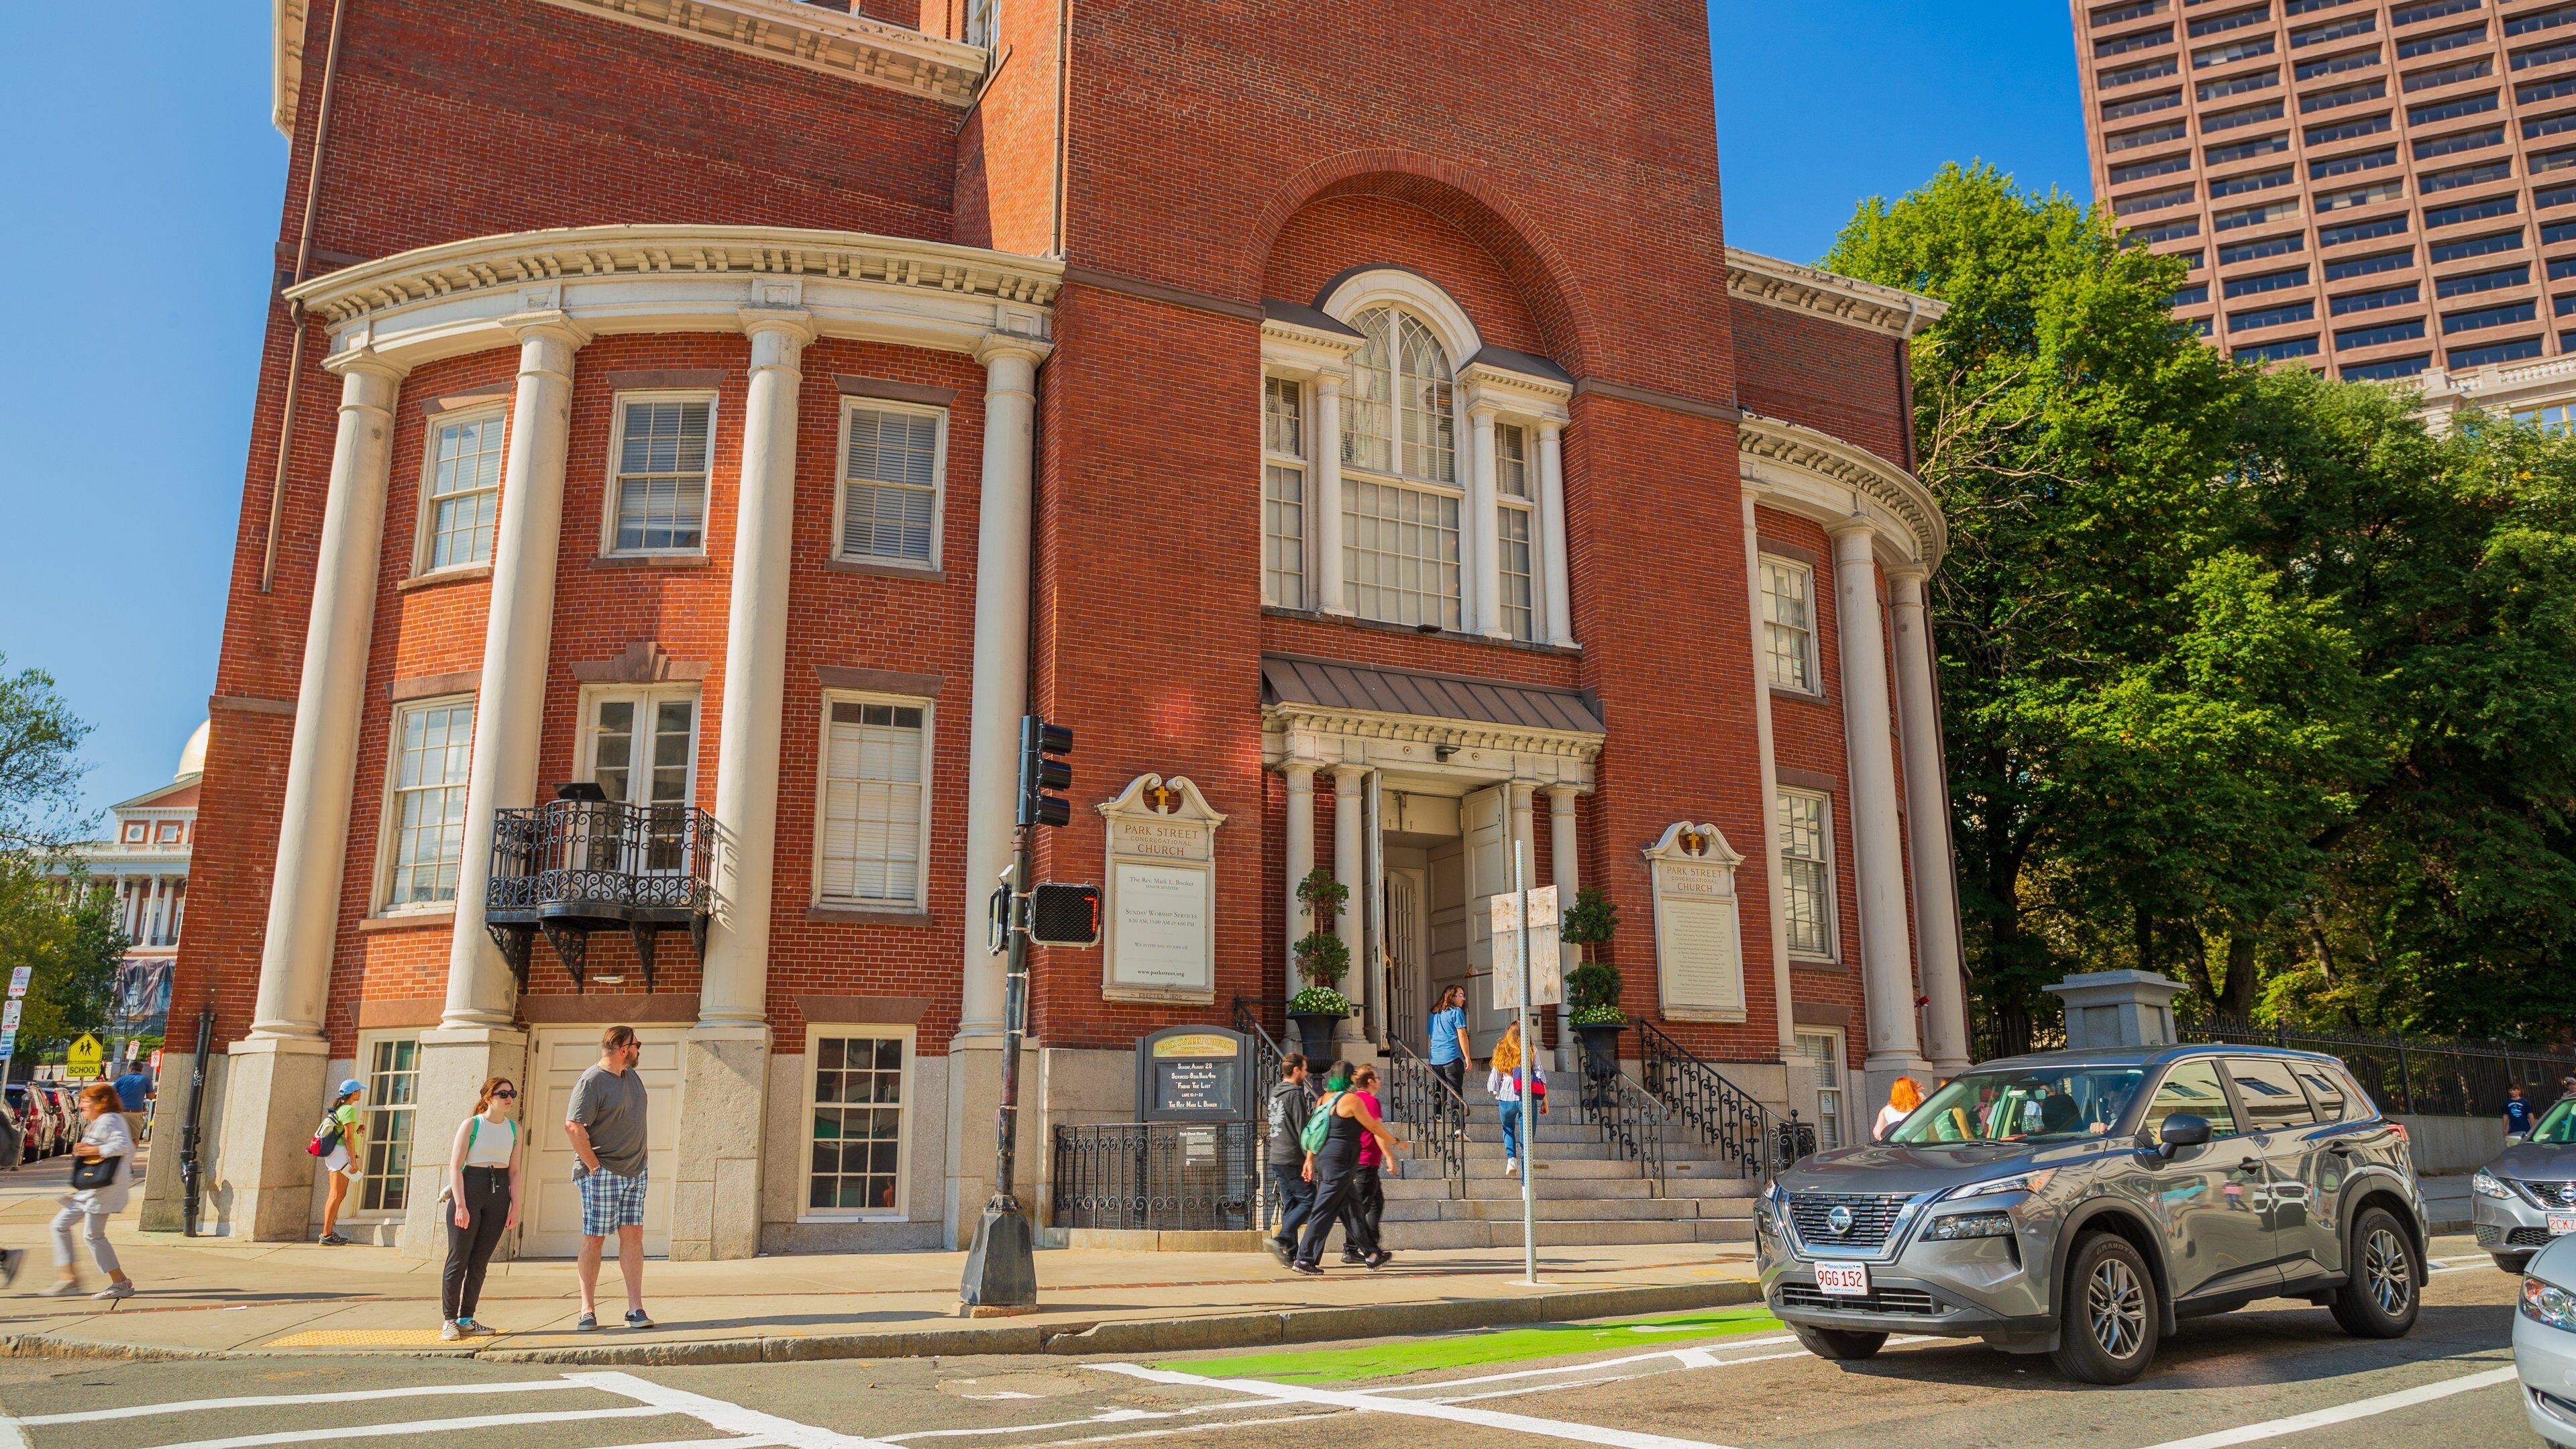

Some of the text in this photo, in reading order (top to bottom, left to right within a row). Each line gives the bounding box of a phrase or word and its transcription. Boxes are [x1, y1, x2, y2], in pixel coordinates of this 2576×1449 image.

[1125, 824, 1198, 839] PARK STREET
[1130, 836, 1191, 846] CONGREGATIONAL
[1138, 844, 1184, 856] CHURCH
[1667, 866, 1722, 878] PARK STREET
[1677, 882, 1713, 893] CHURCH
[1158, 1037, 1236, 1052] PARK STREET CHURCH
[1818, 1270, 1863, 1287] 9GG 152
